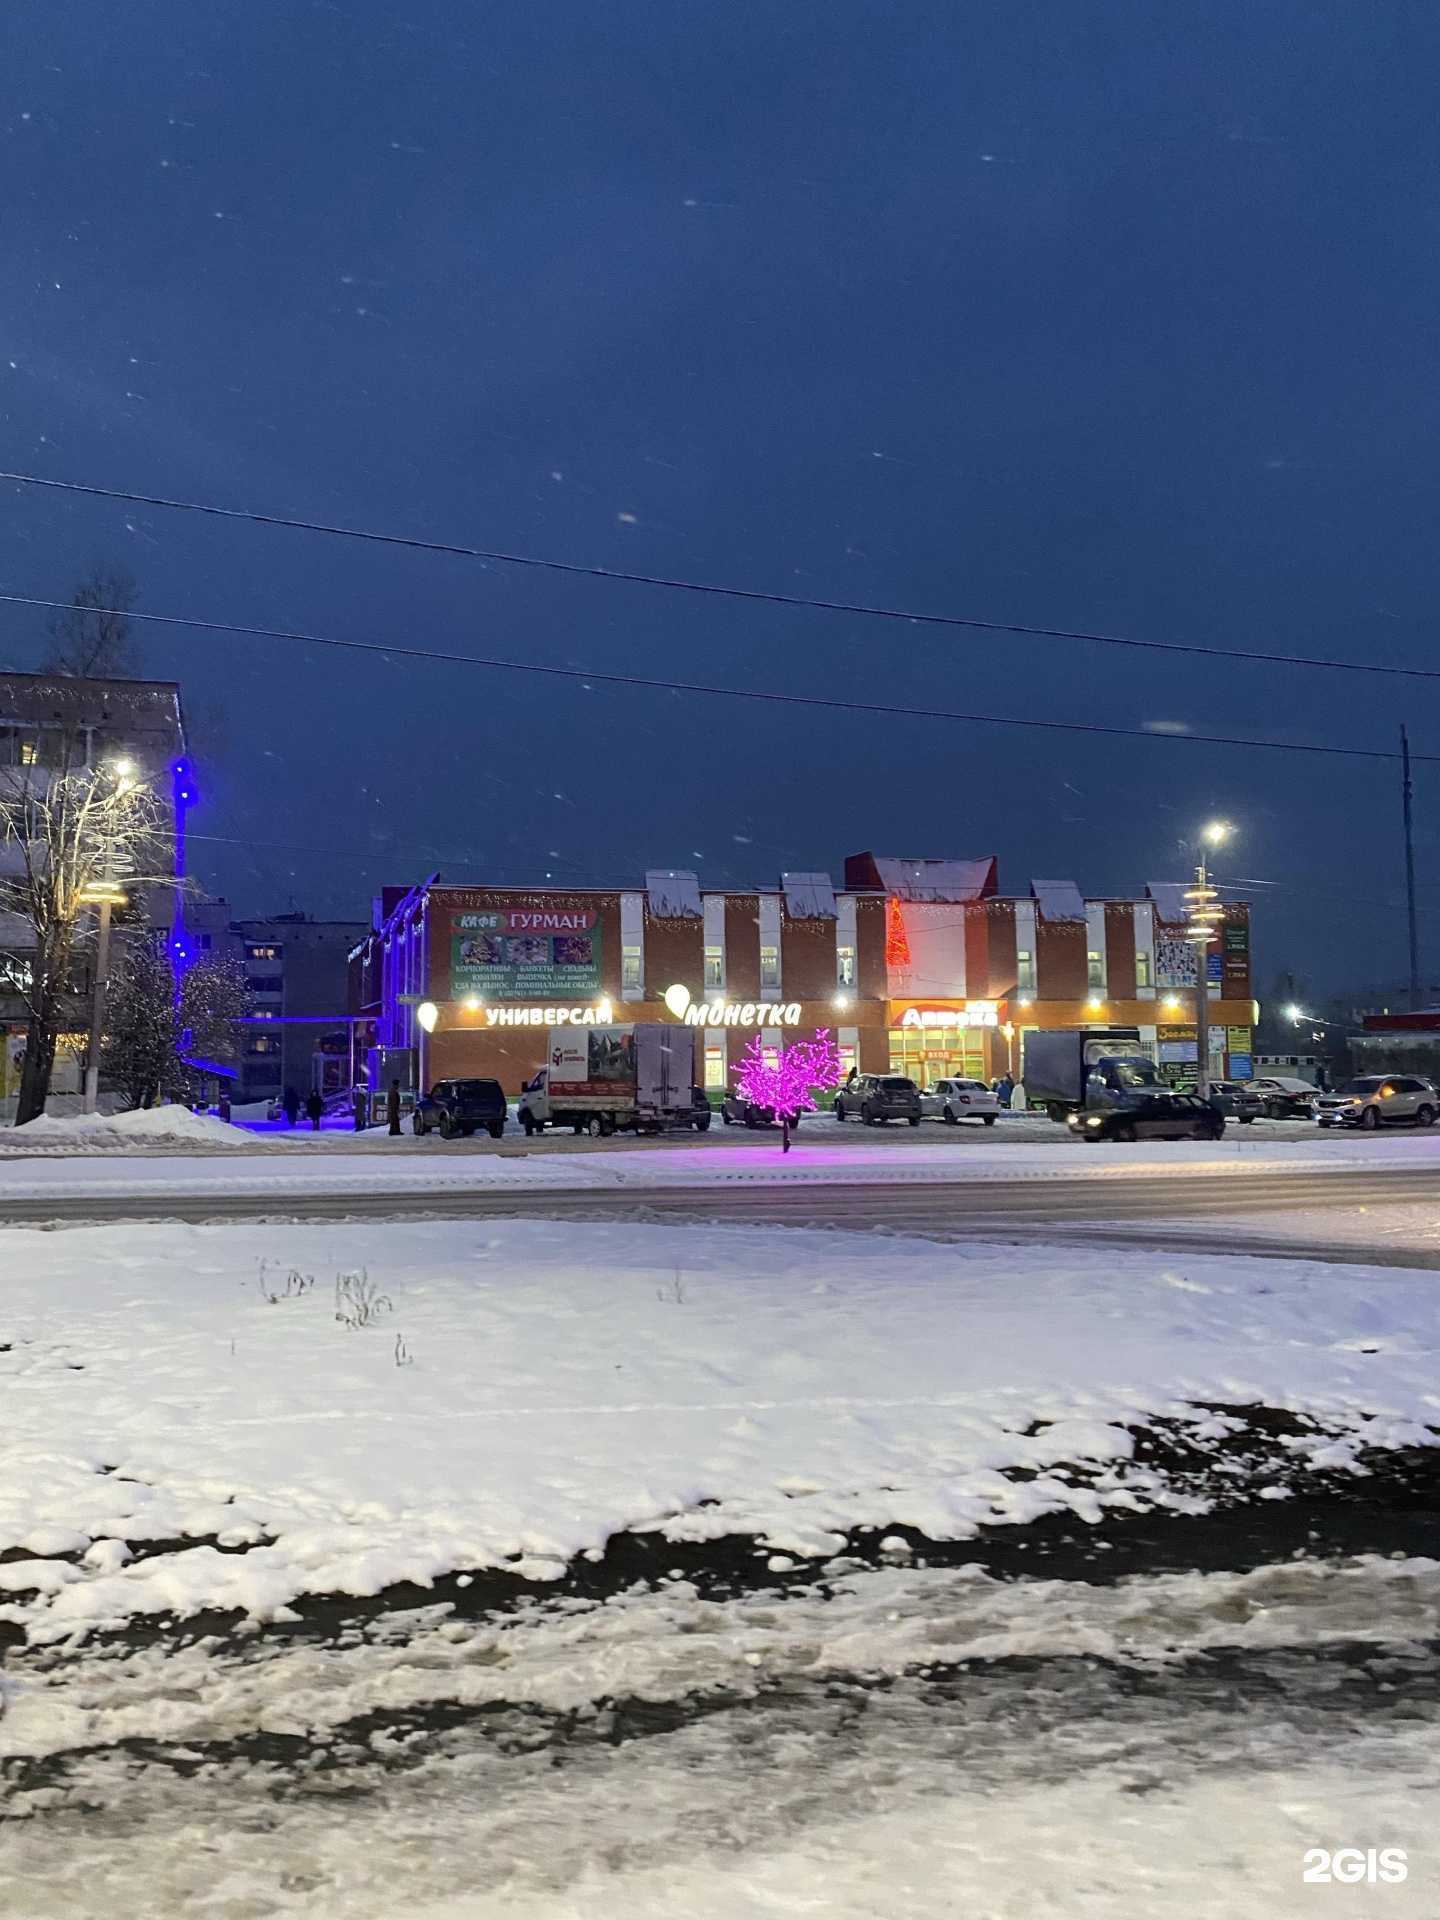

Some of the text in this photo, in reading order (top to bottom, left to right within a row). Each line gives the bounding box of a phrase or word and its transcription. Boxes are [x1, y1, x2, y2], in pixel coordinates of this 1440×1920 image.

[460, 913, 587, 929] КАФЕ ГУРМАН
[485, 1007, 613, 1026] УНИВЕРСАМ
